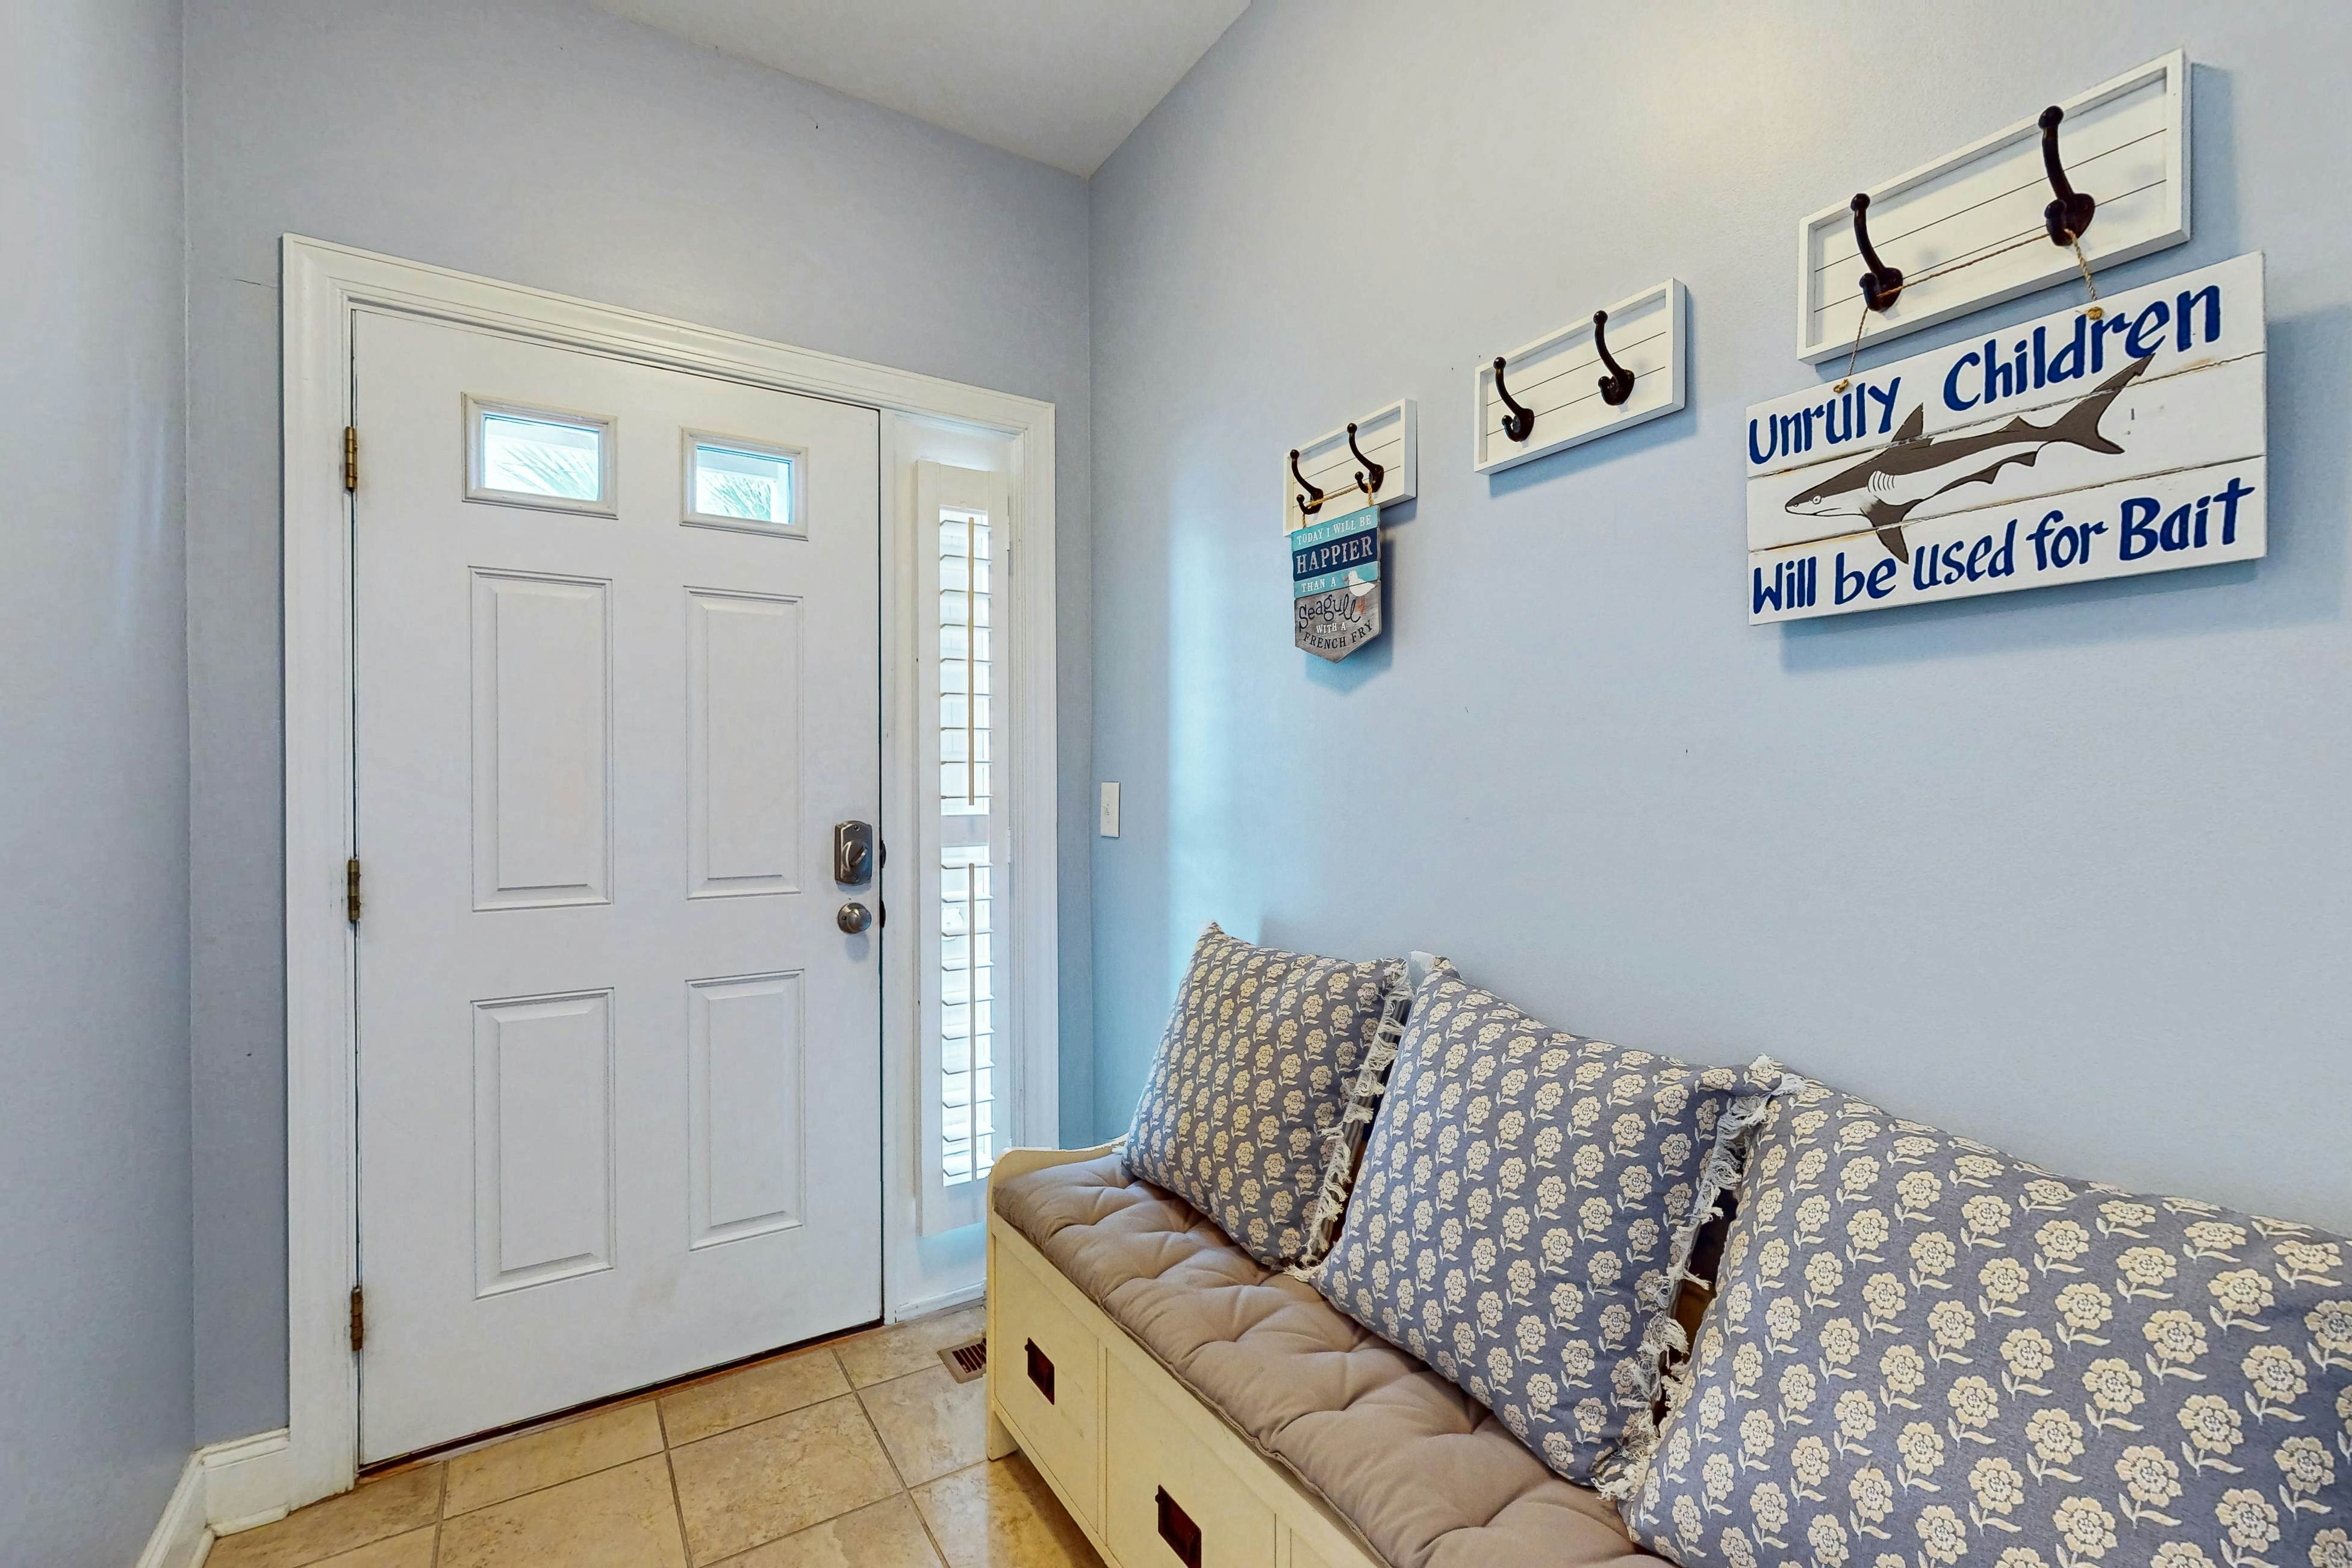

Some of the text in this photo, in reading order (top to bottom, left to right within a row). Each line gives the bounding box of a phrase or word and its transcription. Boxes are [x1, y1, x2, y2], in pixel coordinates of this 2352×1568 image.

[1750, 285, 2220, 464] Unruly Children
[1297, 515, 1371, 545] TODAY I WILL BE
[1753, 478, 2255, 614] Will be used for Bait
[1296, 535, 1373, 574] HAPPIER
[1301, 577, 1336, 593] THAN A
[1299, 593, 1361, 632] Seagull
[1316, 621, 1346, 633] WITH A
[1303, 620, 1373, 649] FRENCH FRY
